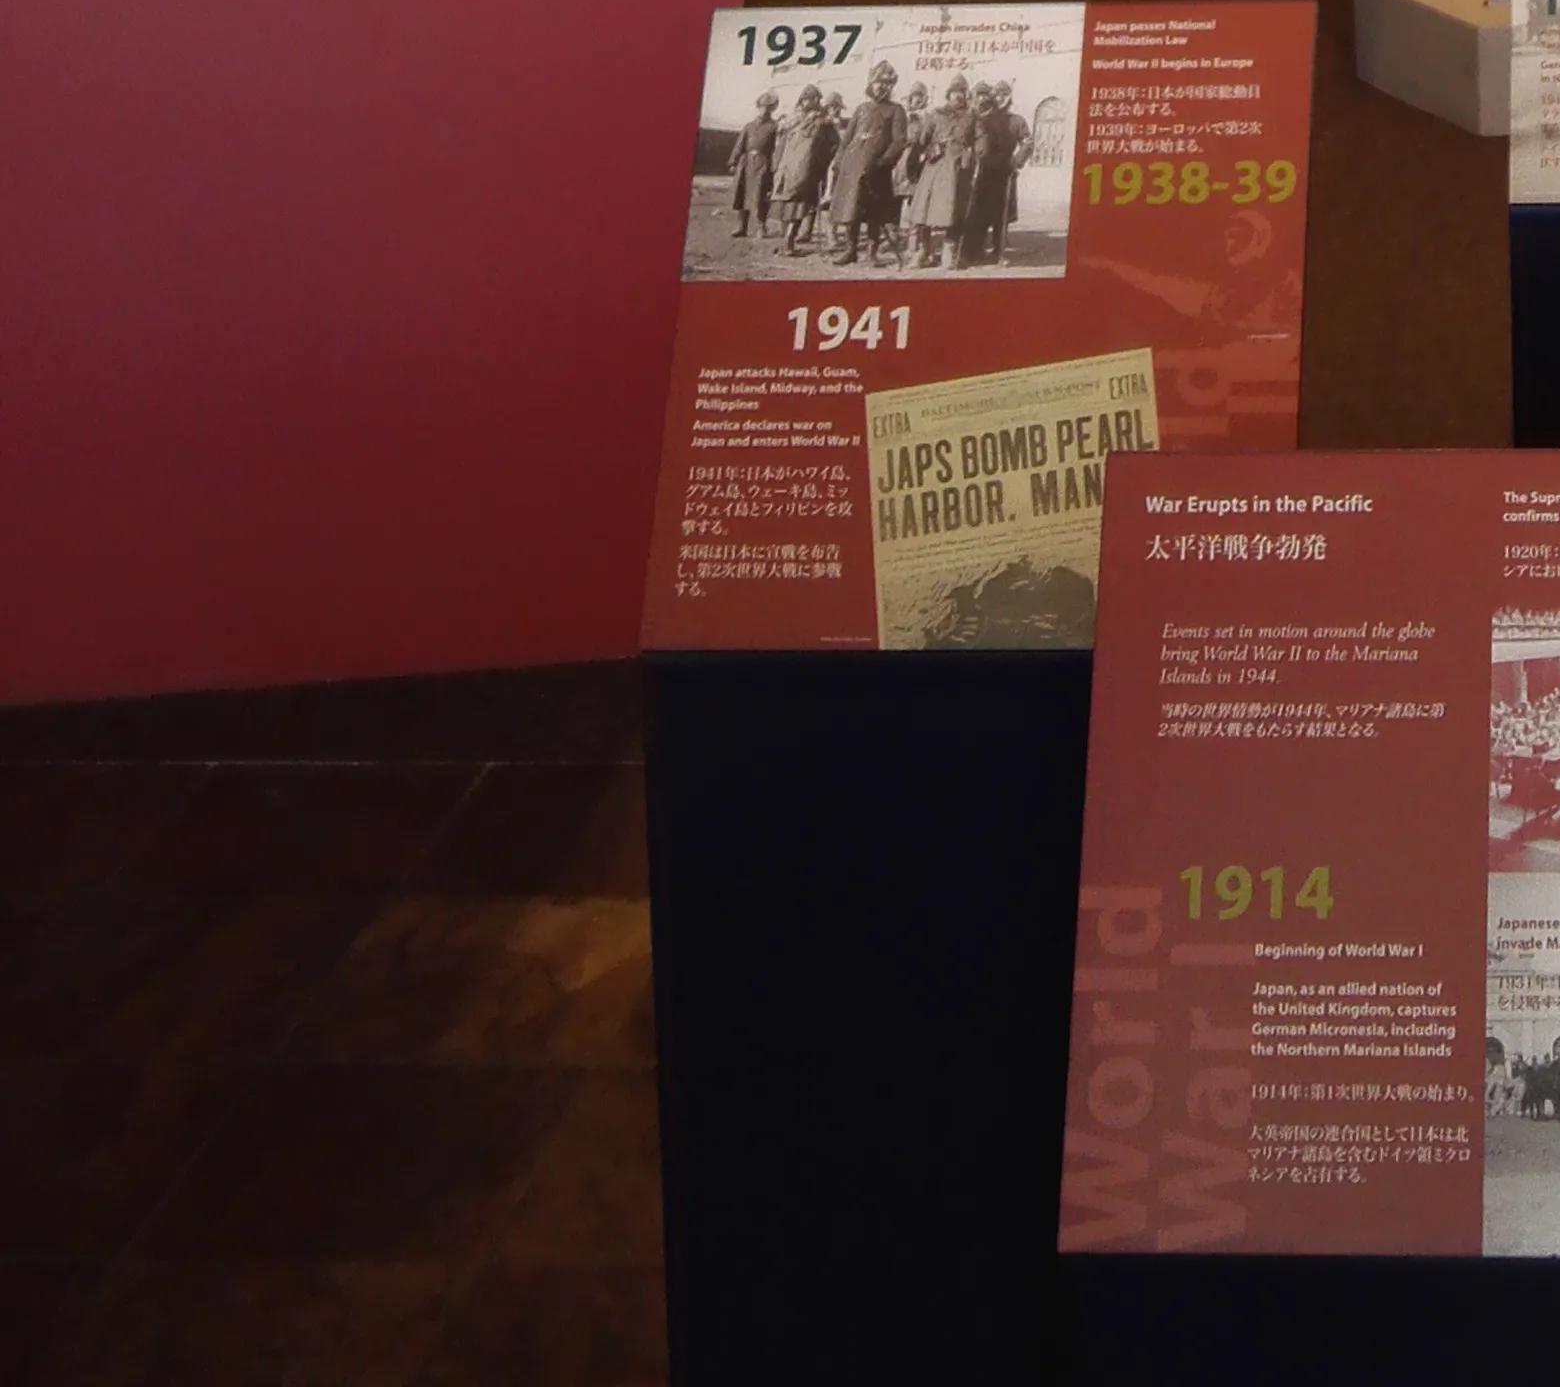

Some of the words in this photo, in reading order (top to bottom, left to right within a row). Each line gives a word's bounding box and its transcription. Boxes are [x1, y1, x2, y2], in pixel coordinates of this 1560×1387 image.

[737, 24, 863, 68] 1937
[1082, 160, 1297, 204] 1938-39
[788, 306, 910, 351] 1941
[698, 368, 734, 380] Japan
[734, 367, 777, 379] attacks
[1109, 373, 1149, 400] EXTRA
[873, 411, 911, 439] EXTRA
[877, 439, 953, 493] JAPS
[961, 423, 1048, 479] BOMB
[1056, 409, 1155, 463] PEARL
[1145, 495, 1183, 513] War
[1187, 495, 1248, 517] Erupts
[1252, 494, 1271, 513] in
[1275, 494, 1308, 513] the
[1311, 494, 1373, 512] Pacific
[1503, 490, 1528, 504] The
[878, 480, 1016, 542] HARBOR.
[1502, 508, 1560, 522] confirms
[1146, 533, 1327, 561] 太平洋戦争勃発
[1161, 622, 1210, 639] Events
[1214, 626, 1235, 639] set
[1238, 623, 1253, 639] in
[1258, 623, 1308, 639] motion
[1312, 621, 1368, 639] around
[1371, 621, 1395, 639] the
[1397, 620, 1436, 642] globe
[1160, 644, 1200, 665] bring
[1204, 644, 1249, 661] World
[1253, 645, 1286, 661] War
[1288, 644, 1302, 662] II
[1306, 648, 1321, 662] to
[1324, 643, 1348, 662] the
[1352, 645, 1419, 661] Mariana
[1159, 667, 1212, 684] Islands
[1217, 668, 1232, 684] in
[1179, 865, 1334, 920] 1914
[1497, 917, 1560, 932] Japanese
[1254, 943, 1325, 960] Beginning
[1328, 942, 1344, 957] of
[1345, 943, 1386, 957] World
[1386, 943, 1416, 957] War
[1418, 943, 1423, 957] I
[1494, 936, 1545, 953] invade
[1252, 981, 1298, 998] Japan,
[1299, 984, 1315, 996] as
[1317, 984, 1335, 996] an
[1338, 981, 1377, 996] allied
[1379, 982, 1425, 996] nation
[1427, 981, 1443, 997] of
